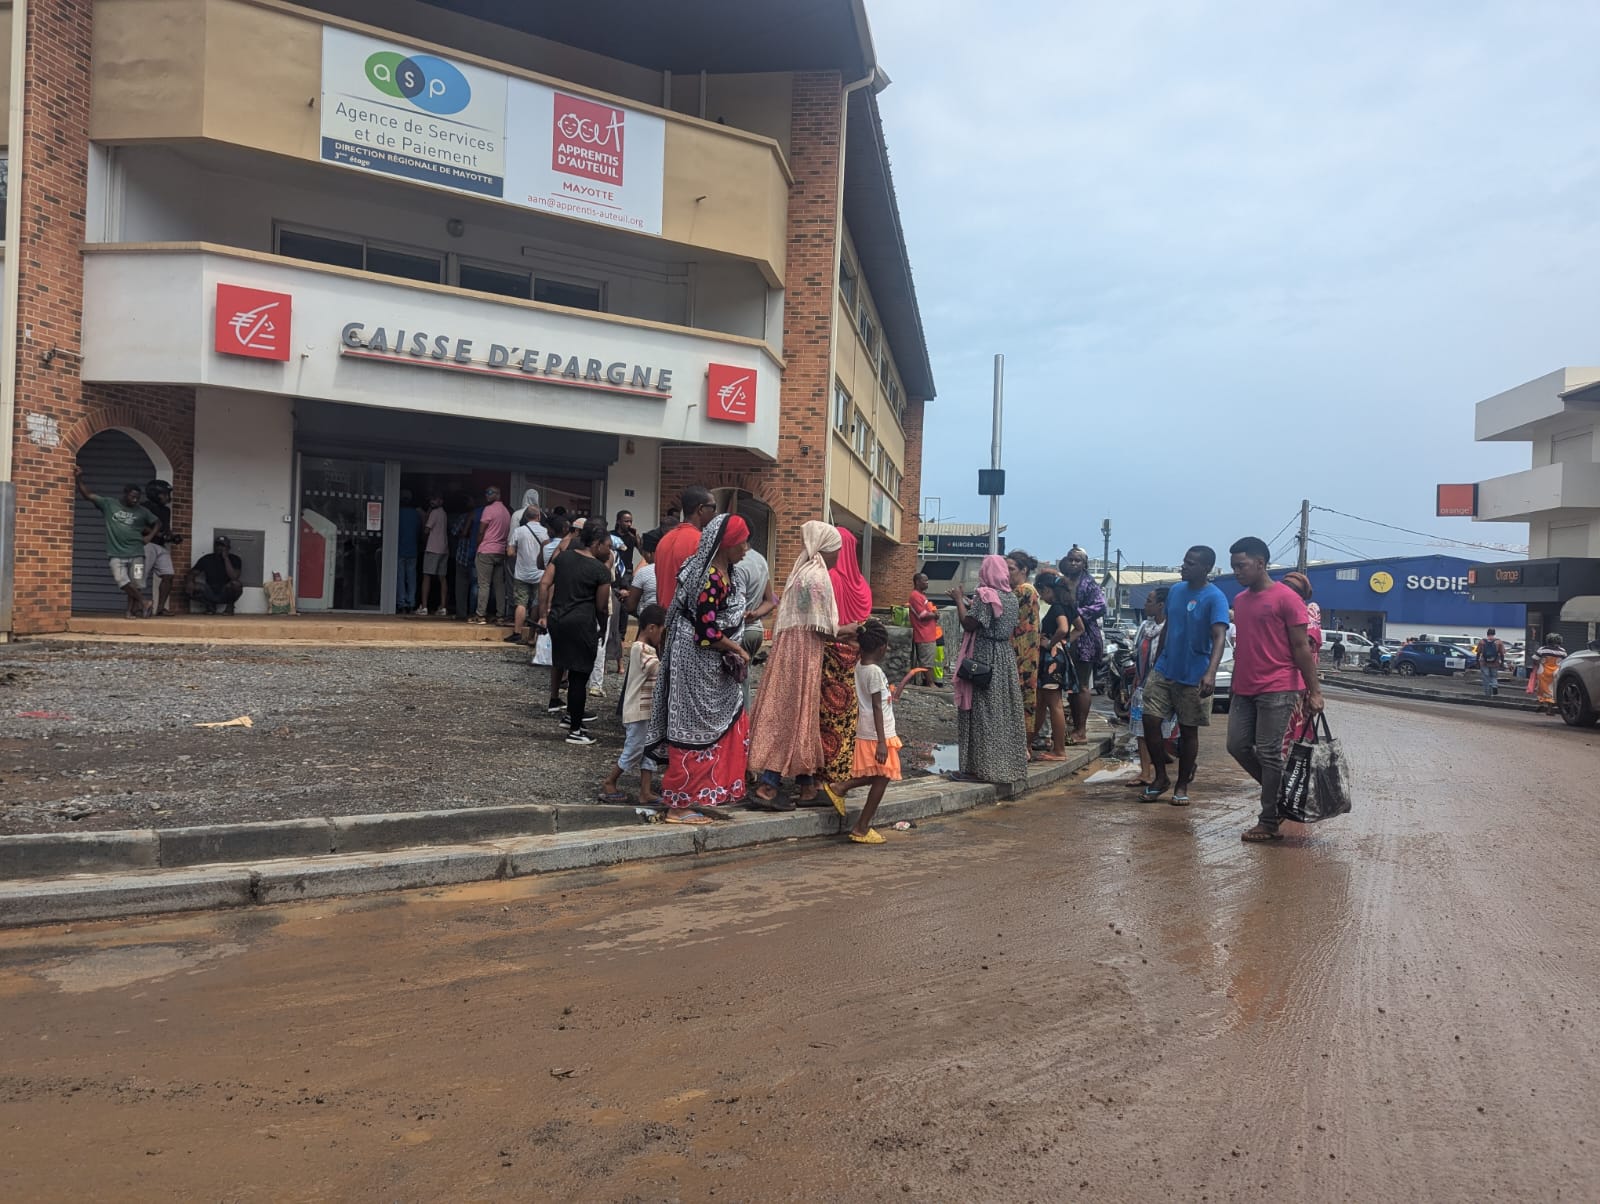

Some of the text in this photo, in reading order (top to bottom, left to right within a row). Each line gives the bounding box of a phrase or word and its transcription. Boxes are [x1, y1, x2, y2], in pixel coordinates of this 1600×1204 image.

[373, 63, 446, 98] asp
[335, 101, 495, 152] Agence de Services
[354, 128, 478, 168] et de Paiement
[558, 143, 619, 167] APPRENTIS
[334, 142, 493, 185] DIRECTION RÉGIONALE DE MAYOTTE
[349, 155, 371, 167] étage
[557, 154, 619, 178] D'AUTEUIL
[562, 181, 614, 201] MAYOTTE
[527, 194, 644, 228] aam@apprentis-auteuil.org
[341, 322, 673, 391] CAISSE D'EPARGNE
[1440, 507, 1470, 515] orange
[1406, 575, 1468, 591] SODIF
[1495, 569, 1519, 583] Orange
